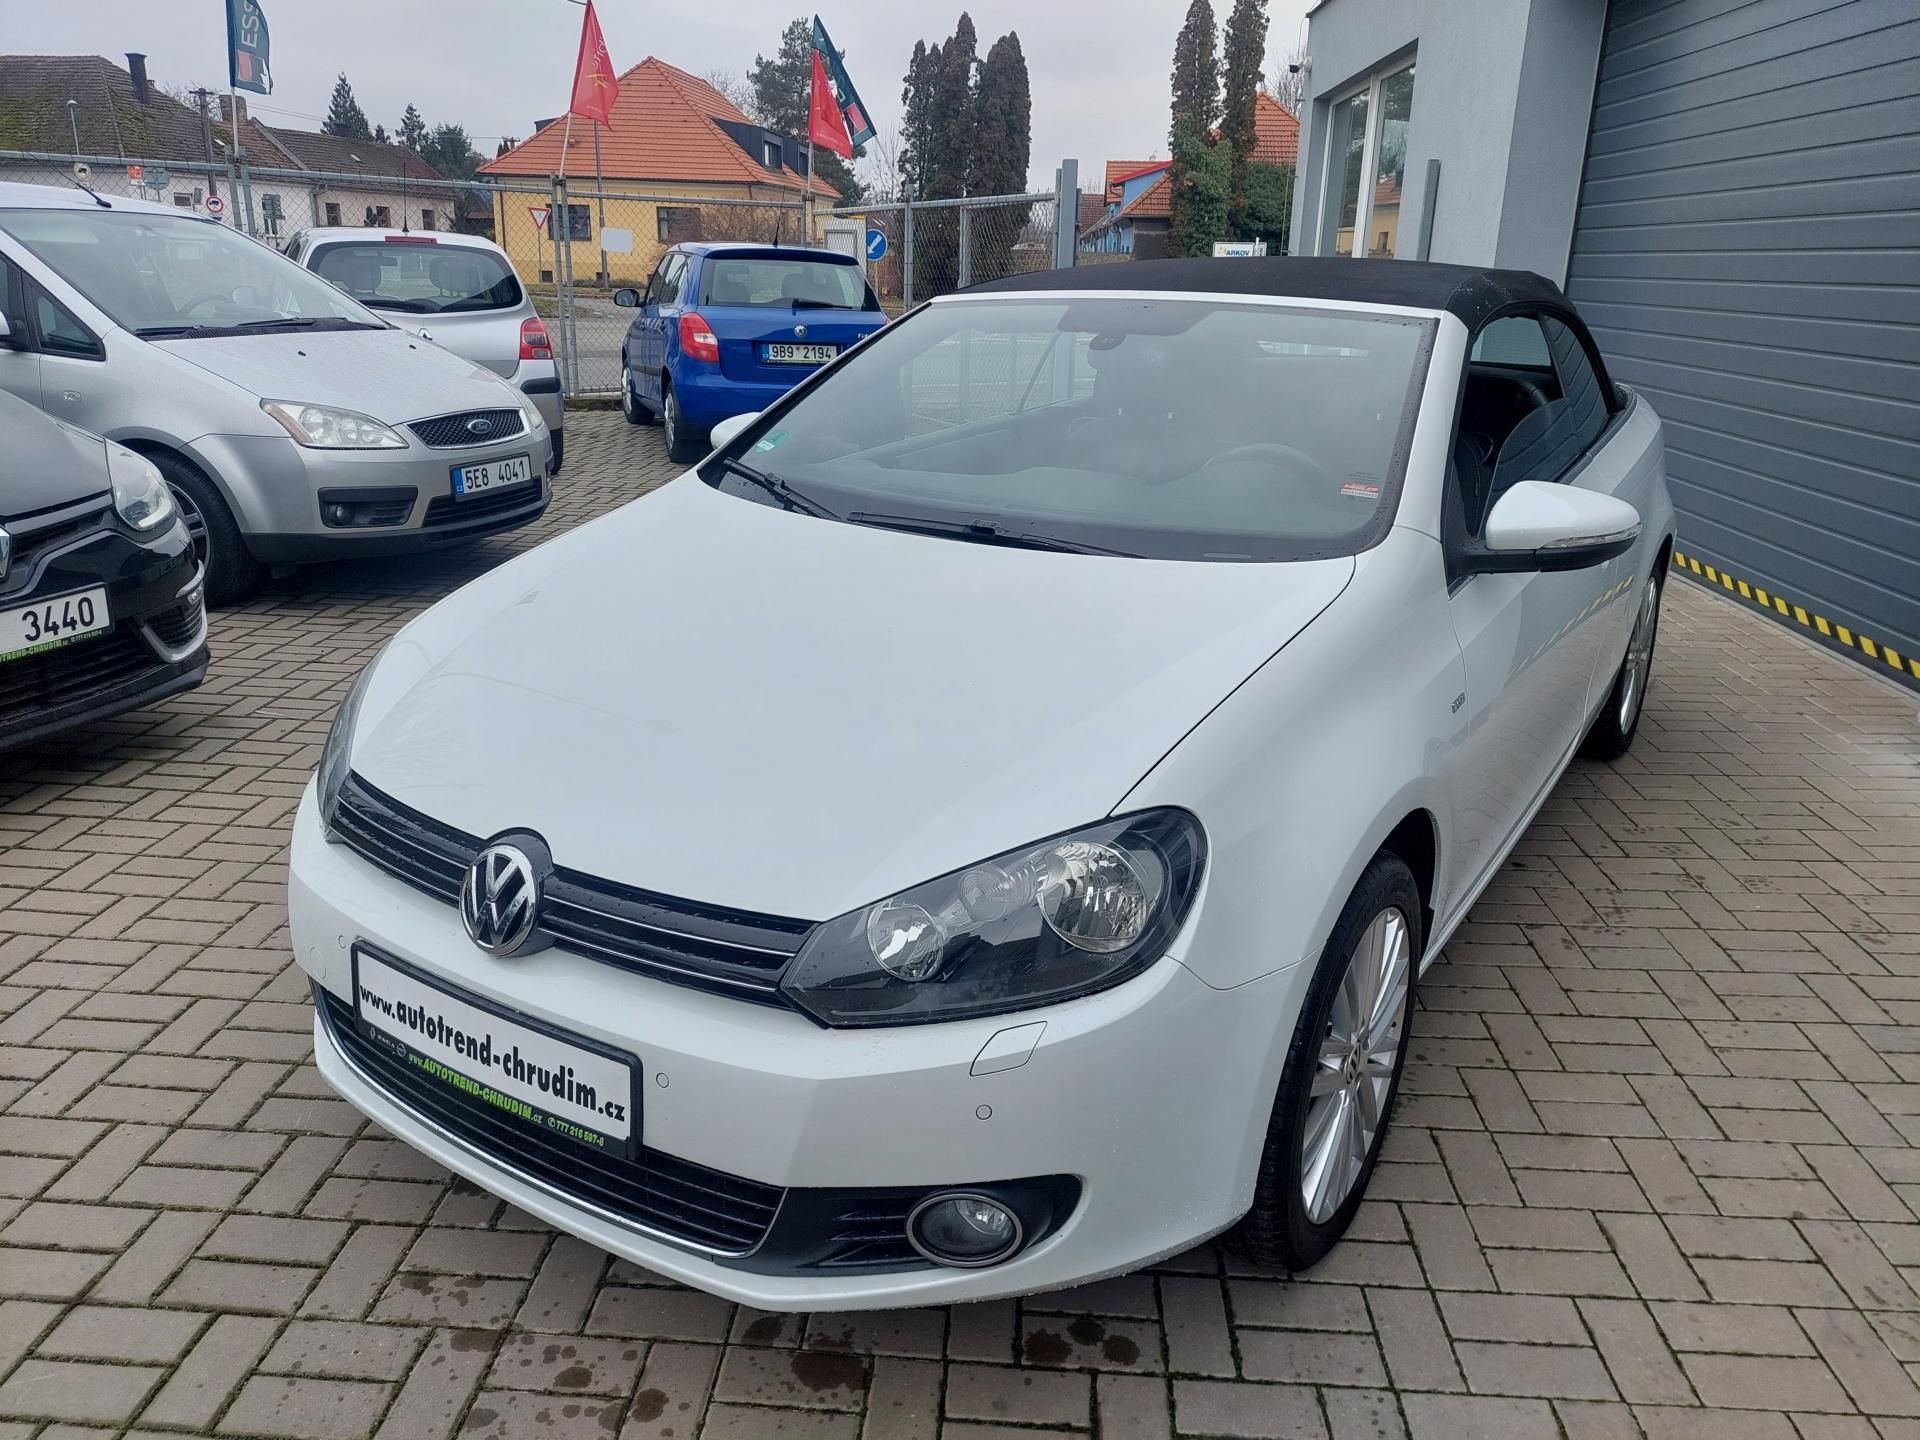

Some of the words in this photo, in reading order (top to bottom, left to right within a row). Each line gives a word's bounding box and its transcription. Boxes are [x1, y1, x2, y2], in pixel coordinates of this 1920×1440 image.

[771, 345, 794, 359] 9B9
[803, 345, 832, 360] 2194
[465, 467, 489, 490] 5E8
[498, 459, 526, 483] 4041
[22, 597, 95, 641] 3440
[359, 984, 625, 1122] www.autotrend-chrudim.cz
